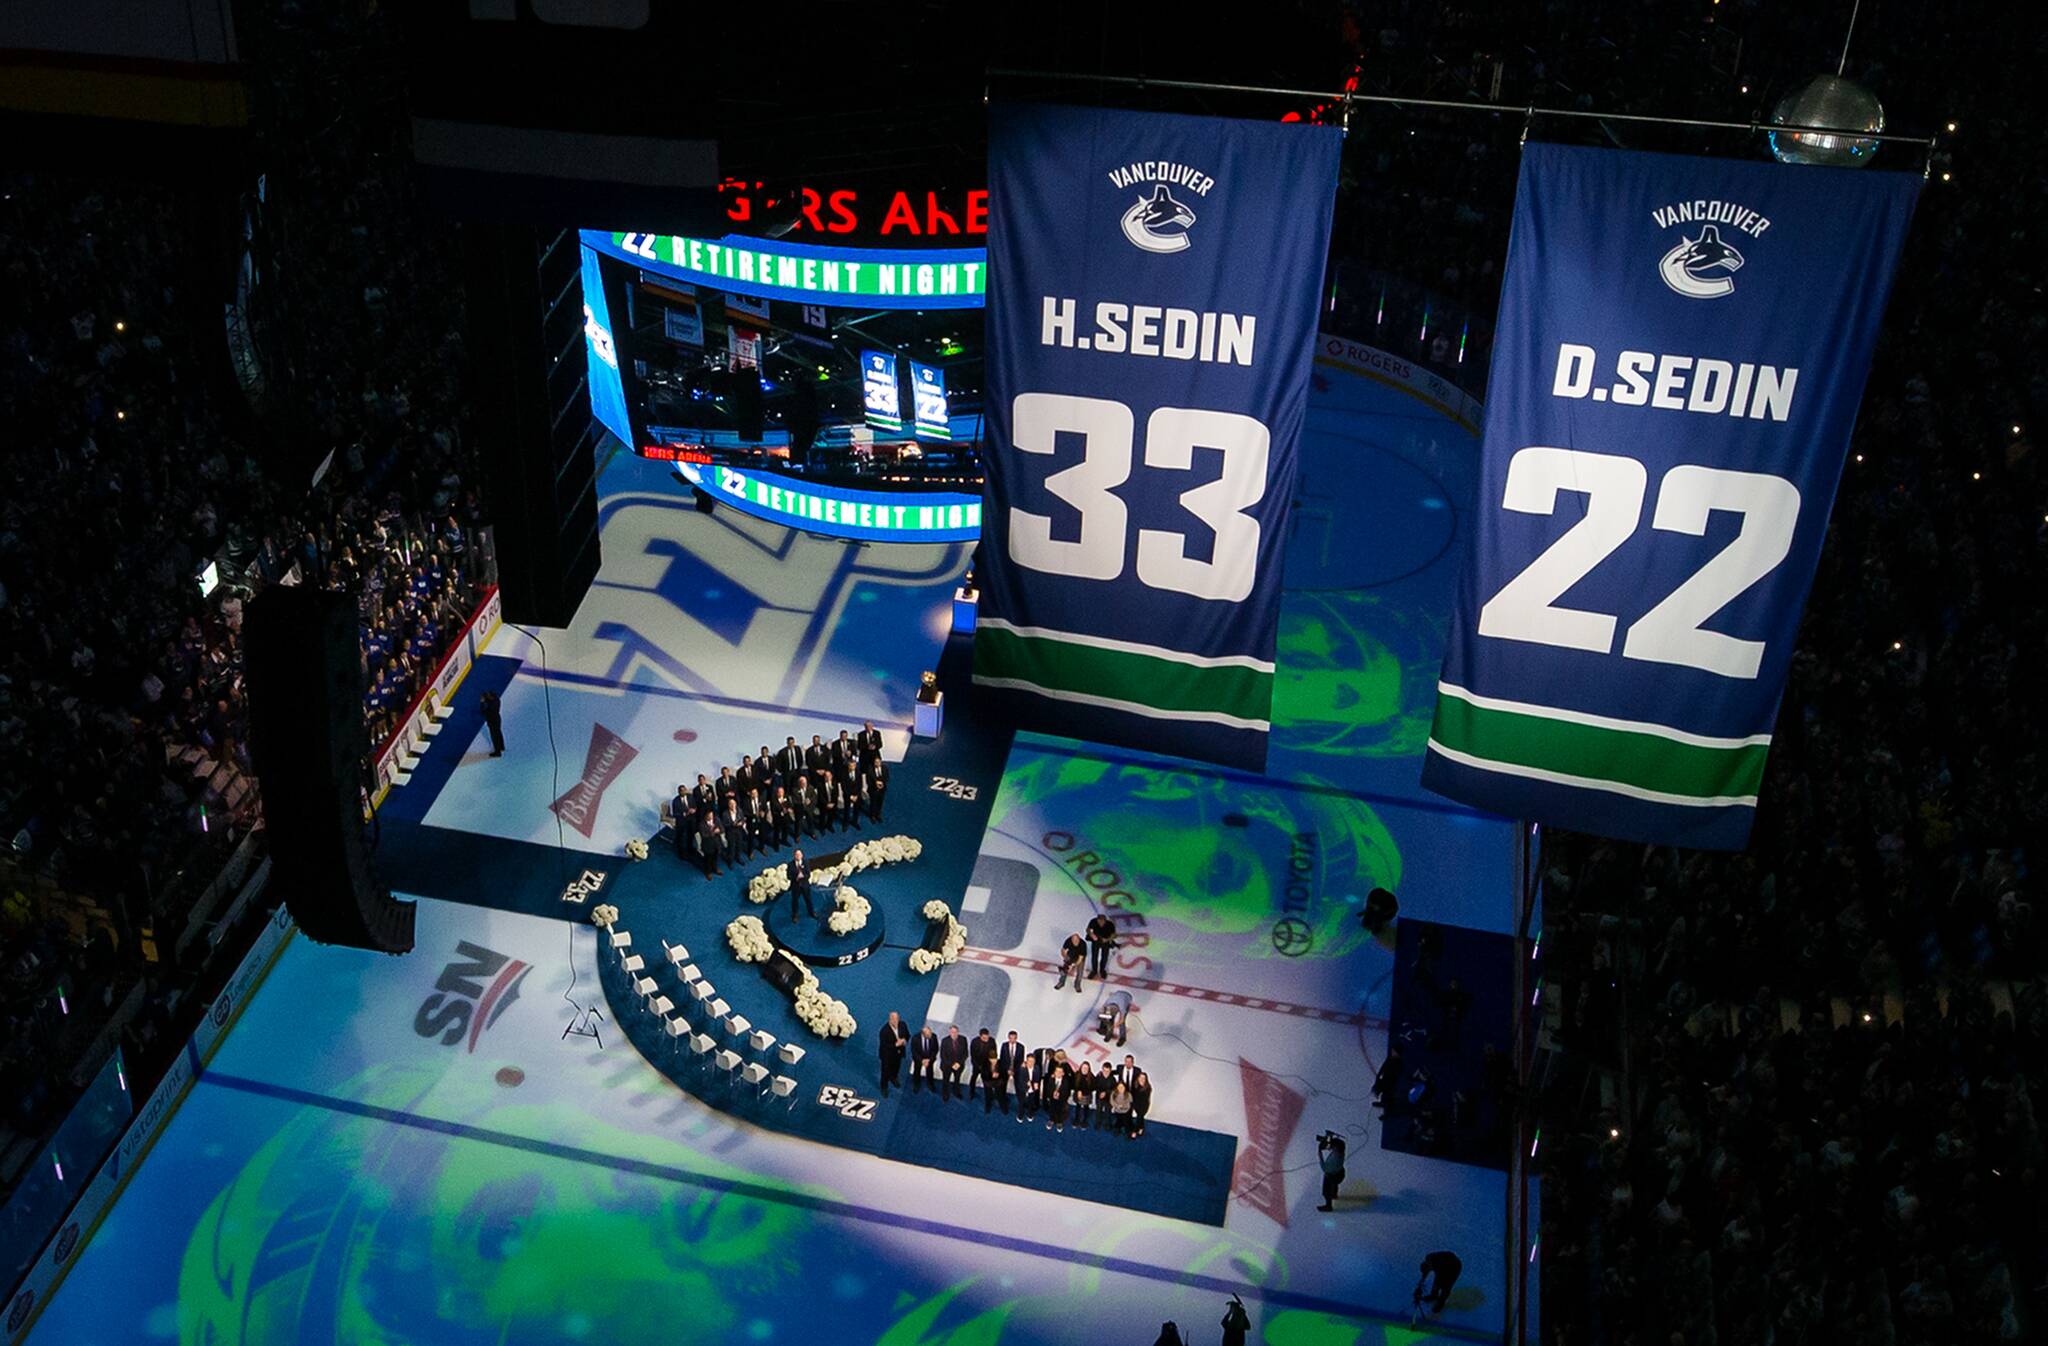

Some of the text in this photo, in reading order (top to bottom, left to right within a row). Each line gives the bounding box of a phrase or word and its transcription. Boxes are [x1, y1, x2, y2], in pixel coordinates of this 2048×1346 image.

[1109, 161, 1215, 197] VANCOUVER
[1652, 200, 1771, 238] VANCOUVER
[672, 235, 861, 293] RETIREMENT
[879, 263, 980, 296] NIGHT
[1041, 296, 1256, 366] H.SEDIN
[1347, 346, 1410, 378] ROGERS
[1552, 343, 1799, 422] D.SEDIN
[721, 466, 748, 499] 22
[757, 482, 907, 529] RETIREMENT
[1009, 392, 1271, 603] 33
[1477, 446, 1801, 679] 22
[559, 735, 622, 825] Budweiser
[1283, 831, 1317, 914] TOYOTA
[120, 1066, 184, 1157] vistaprint
